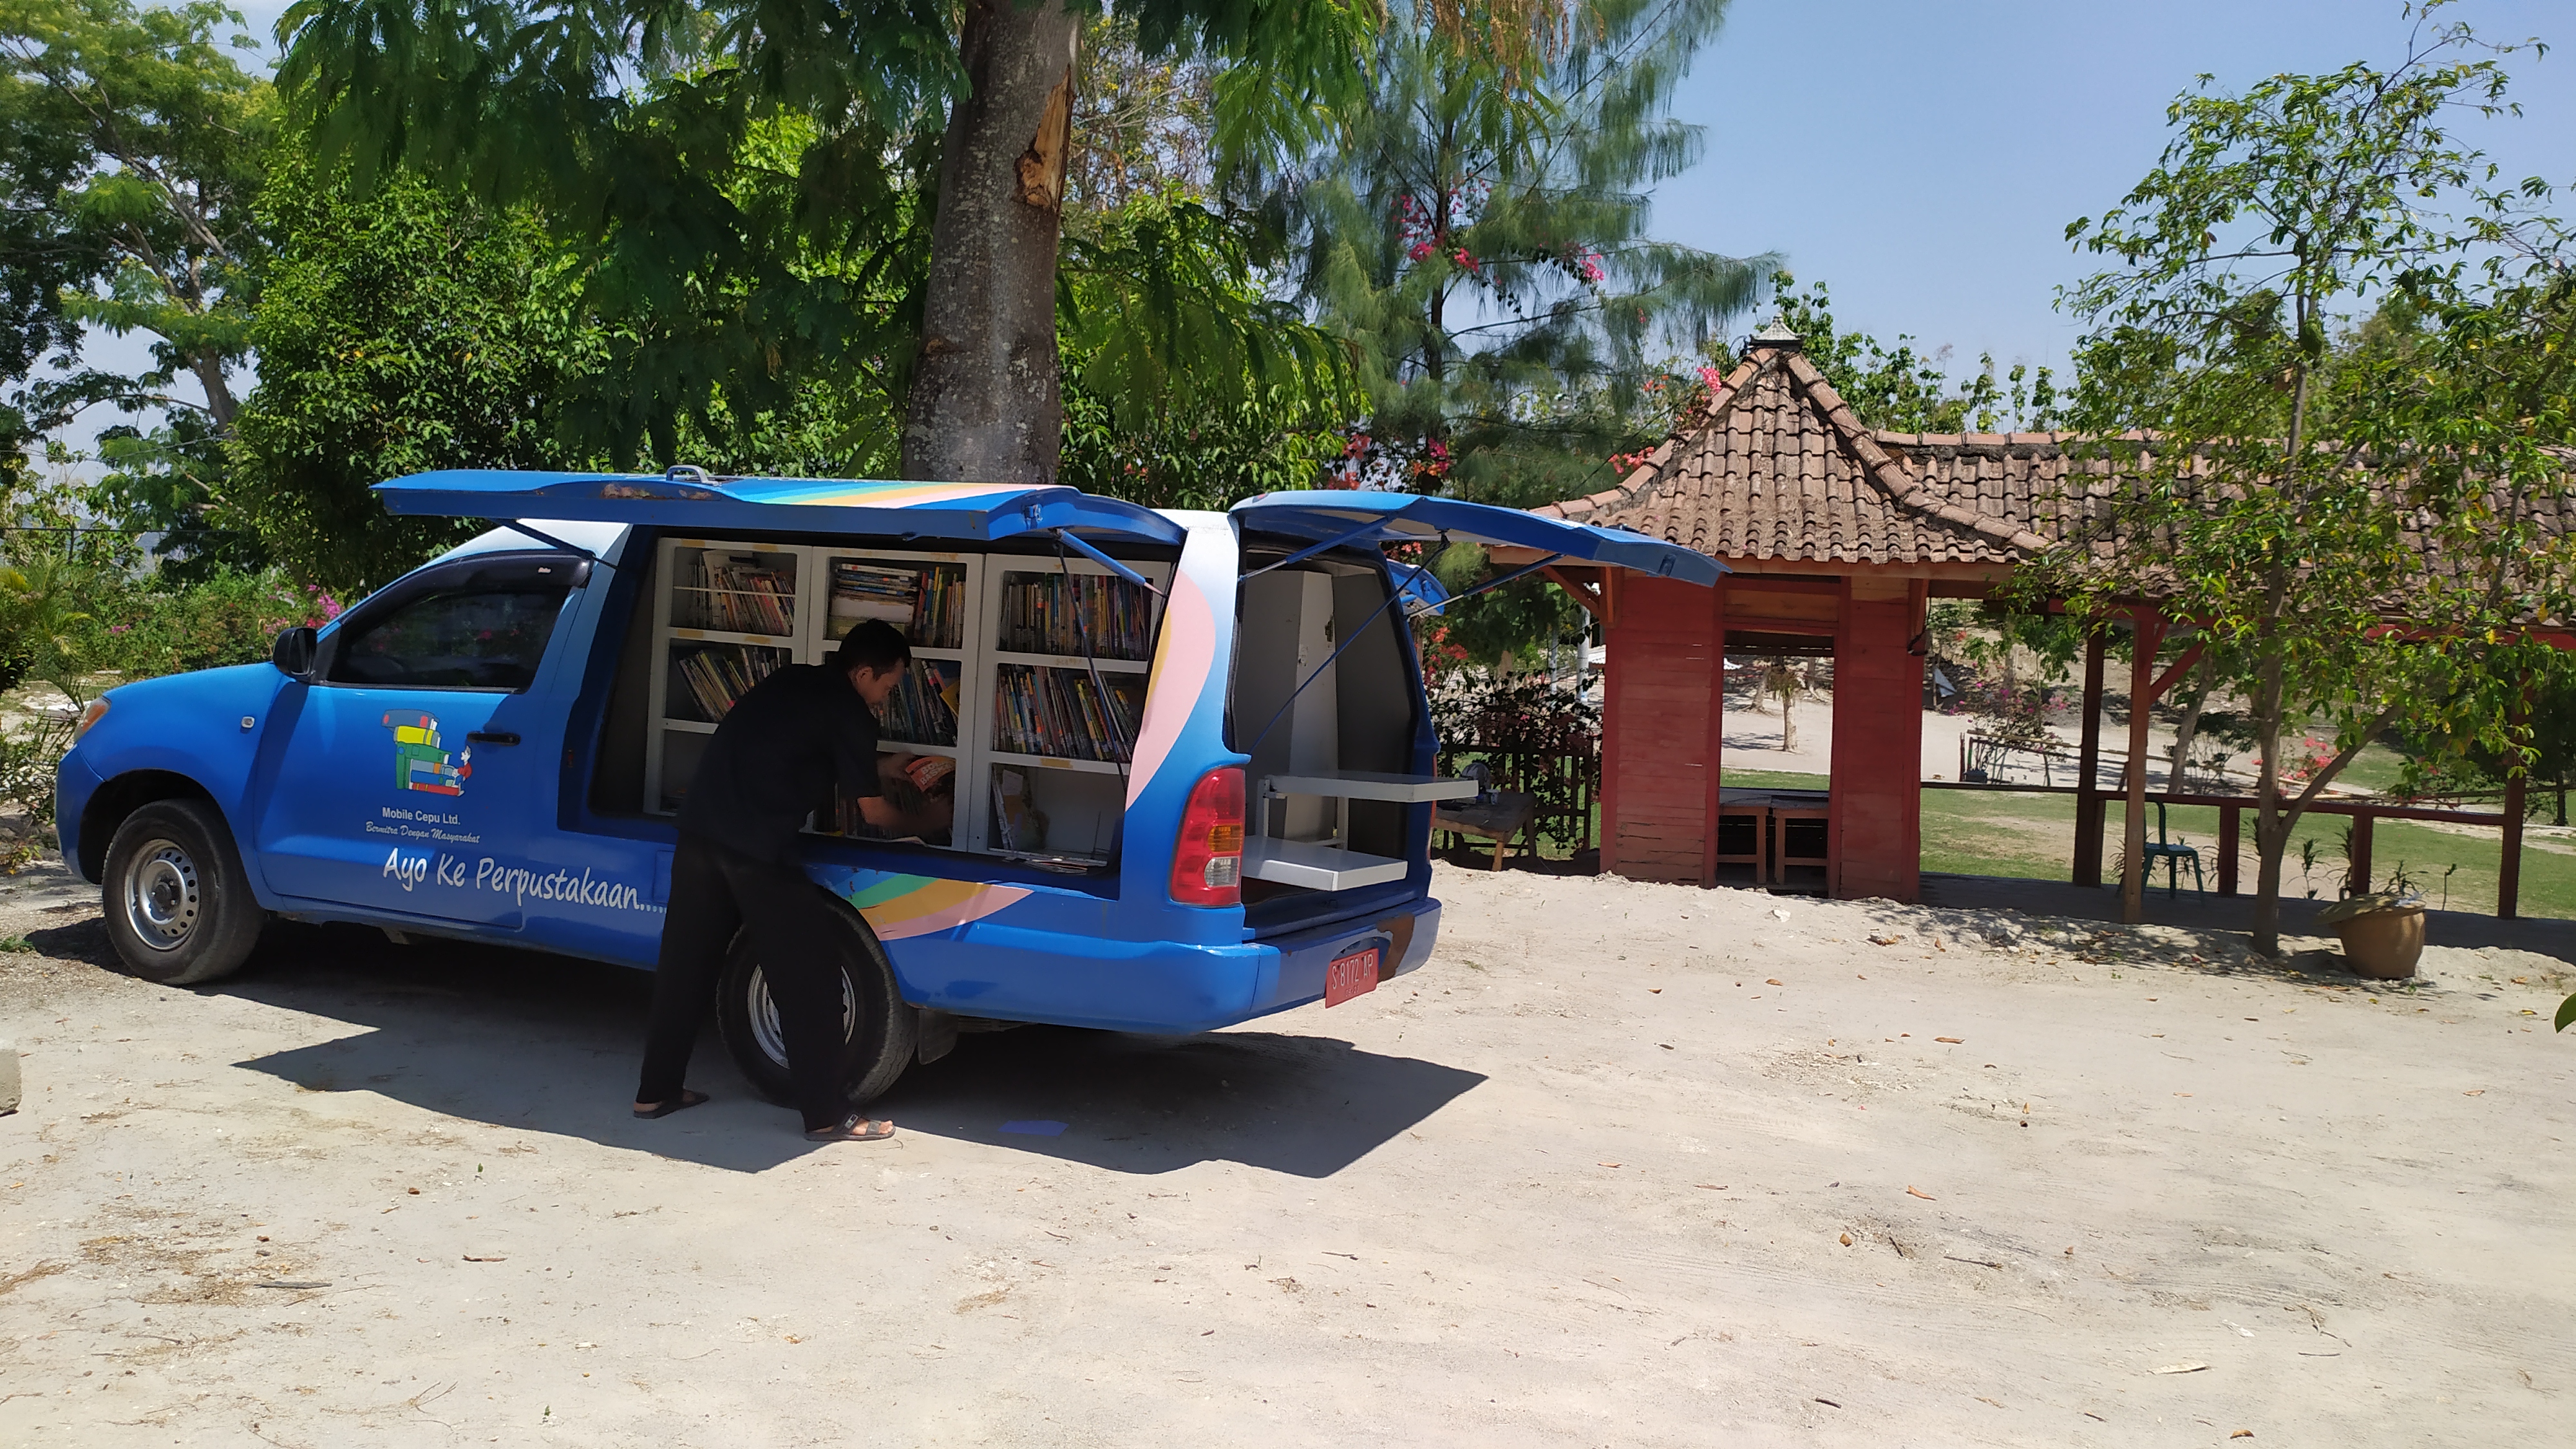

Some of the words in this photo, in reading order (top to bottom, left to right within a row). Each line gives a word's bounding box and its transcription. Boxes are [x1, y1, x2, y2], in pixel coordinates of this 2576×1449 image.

[383, 807, 413, 820] Mobile
[415, 810, 440, 824] Cepu
[442, 813, 461, 825] Ltd.
[366, 821, 398, 835] Bermitra
[400, 825, 430, 840] Dengan
[431, 828, 480, 843] Masyarakat
[383, 848, 427, 891] Ayo
[437, 853, 466, 887] Ke
[1332, 965, 1337, 990] S
[1340, 958, 1359, 986] 8172
[1363, 954, 1373, 978] AP
